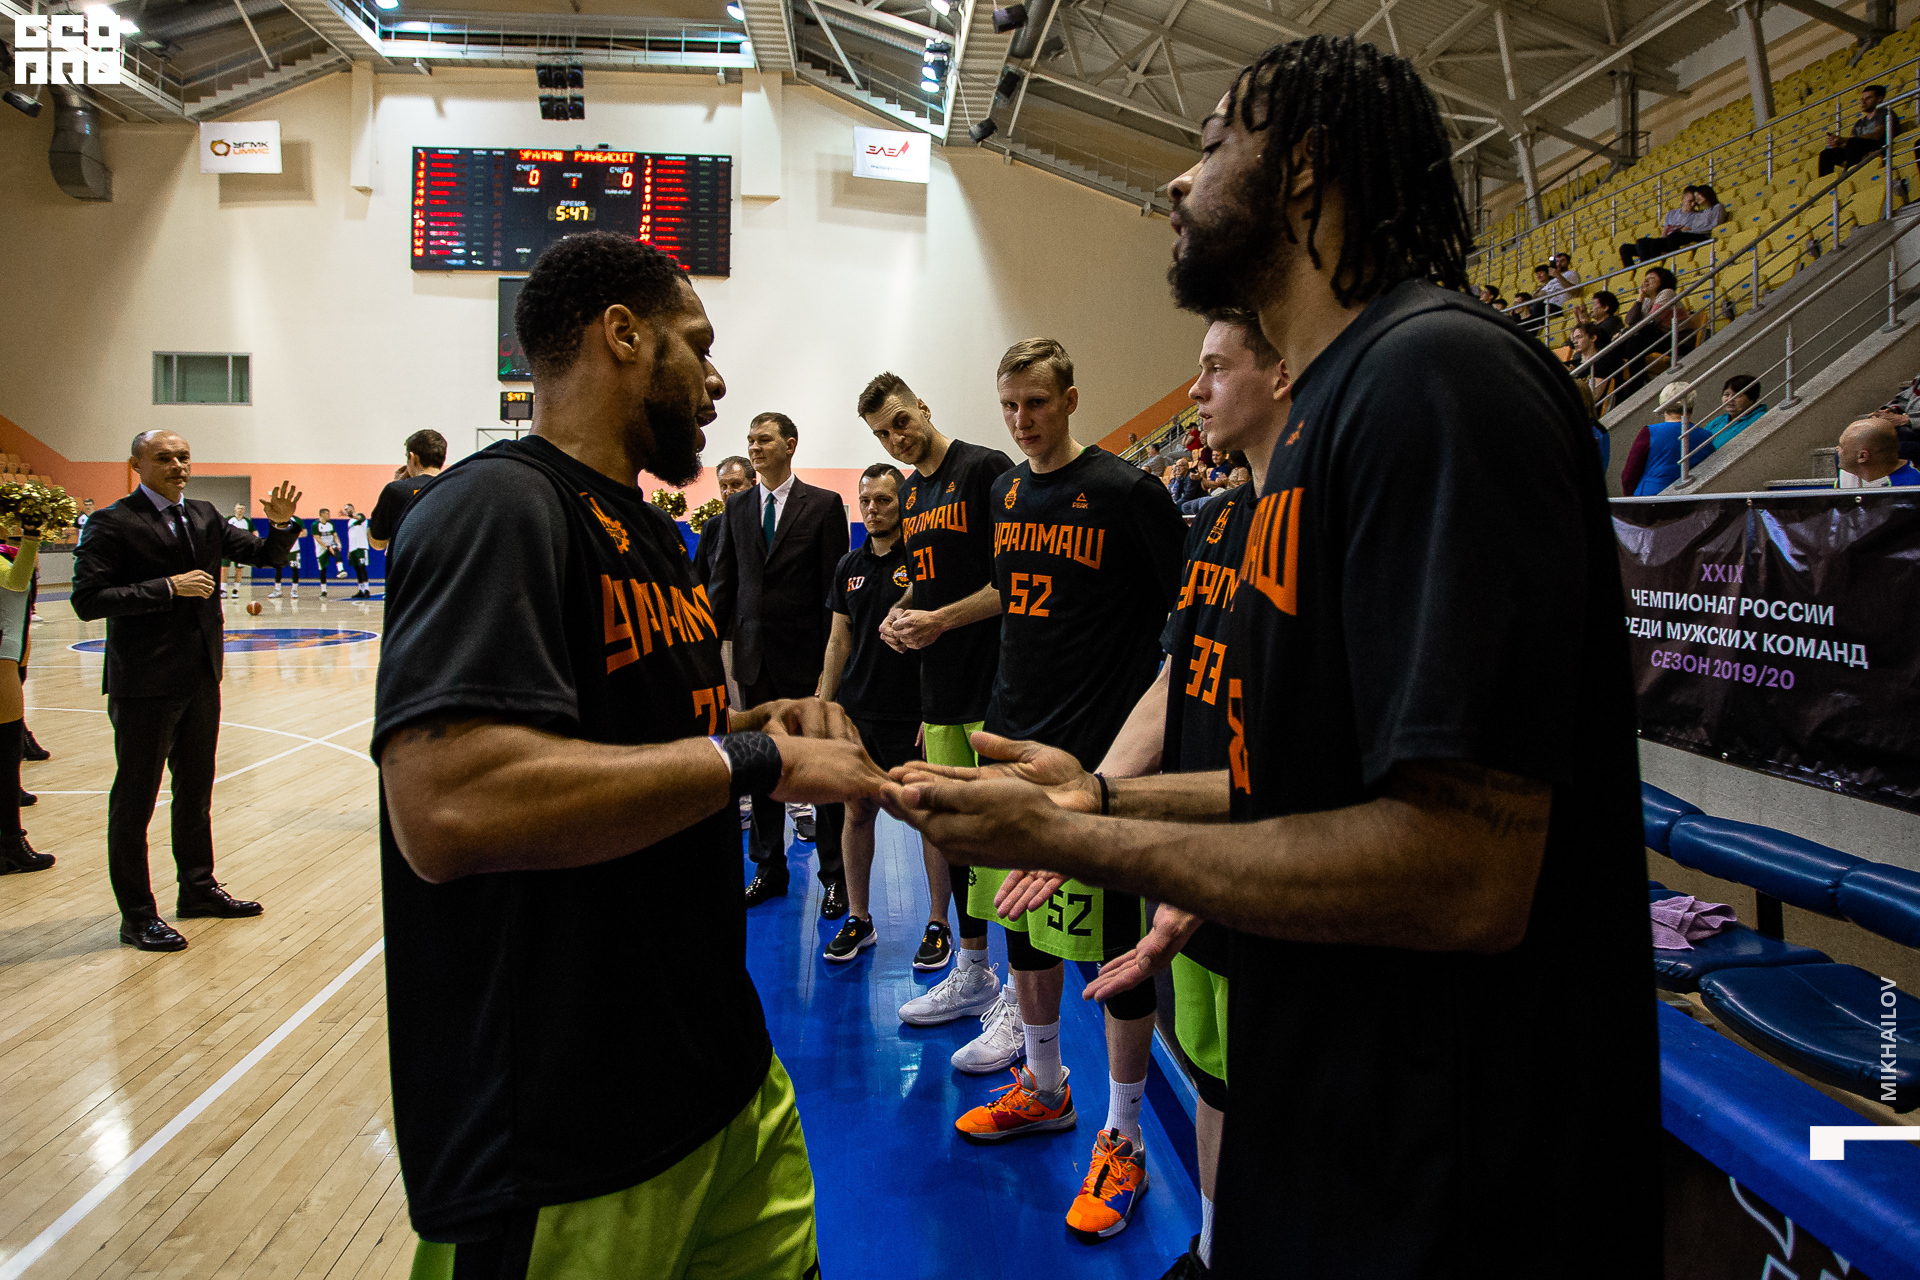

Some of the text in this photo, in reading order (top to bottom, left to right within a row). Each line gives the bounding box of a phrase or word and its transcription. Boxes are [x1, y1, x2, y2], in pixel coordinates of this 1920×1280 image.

[519, 149, 564, 162] УРАЛМАШ
[528, 169, 540, 186] 0
[571, 176, 578, 189] 1
[621, 171, 634, 188] 0
[555, 205, 589, 221] 5:47
[507, 392, 527, 401] 5:47
[994, 522, 1106, 571] УРАЛМАШ
[913, 546, 935, 581] 31
[1700, 563, 1744, 584] XXIX
[847, 576, 865, 592] KD
[1008, 572, 1053, 618] 52
[1631, 588, 1835, 626] ЧЕМПИОНАТ РОССИИ
[1666, 621, 1757, 652] МУЖСКИХ
[1762, 632, 1869, 670] КОМАНД
[1185, 634, 1228, 706] 33
[1651, 649, 1796, 690] СЕЗОН 2019/20
[1047, 888, 1093, 937] 52
